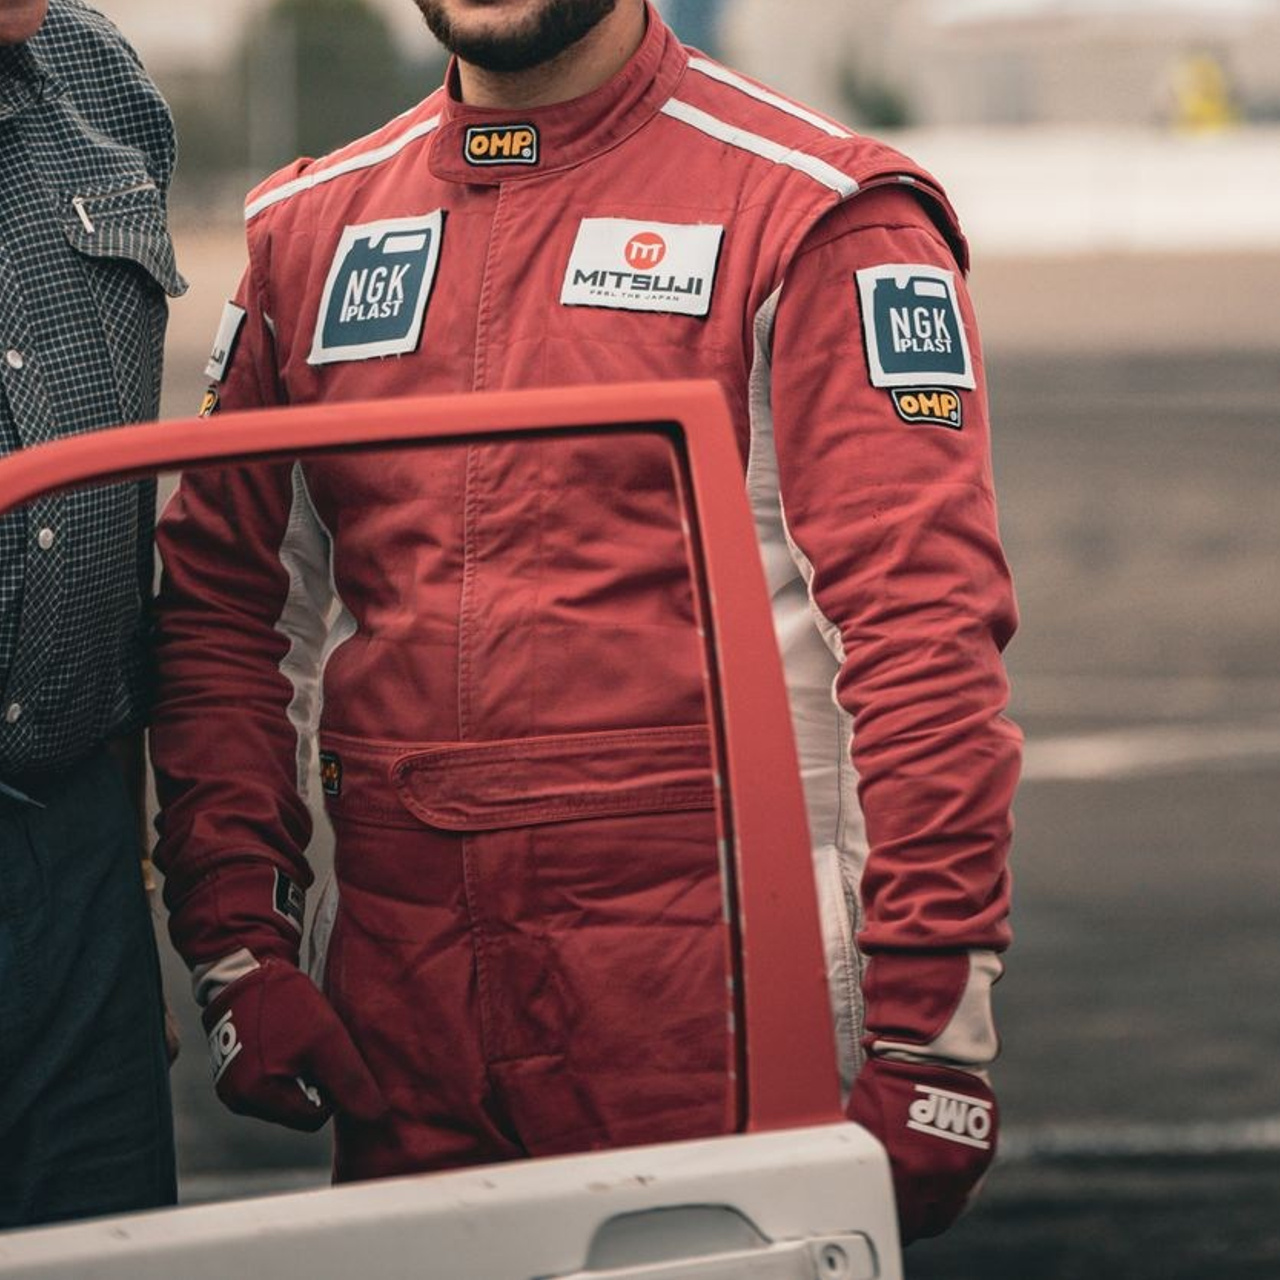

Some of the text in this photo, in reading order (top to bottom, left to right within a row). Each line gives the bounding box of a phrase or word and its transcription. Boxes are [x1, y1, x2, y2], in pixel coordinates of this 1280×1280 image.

[470, 131, 532, 156] OMP
[341, 263, 411, 322] NGK
[573, 269, 703, 295] MITSUJI
[346, 300, 404, 322] PLAST
[889, 307, 951, 353] NGK
[901, 339, 952, 353] PLAST
[901, 393, 957, 417] OMP
[908, 1093, 992, 1140] OMP
